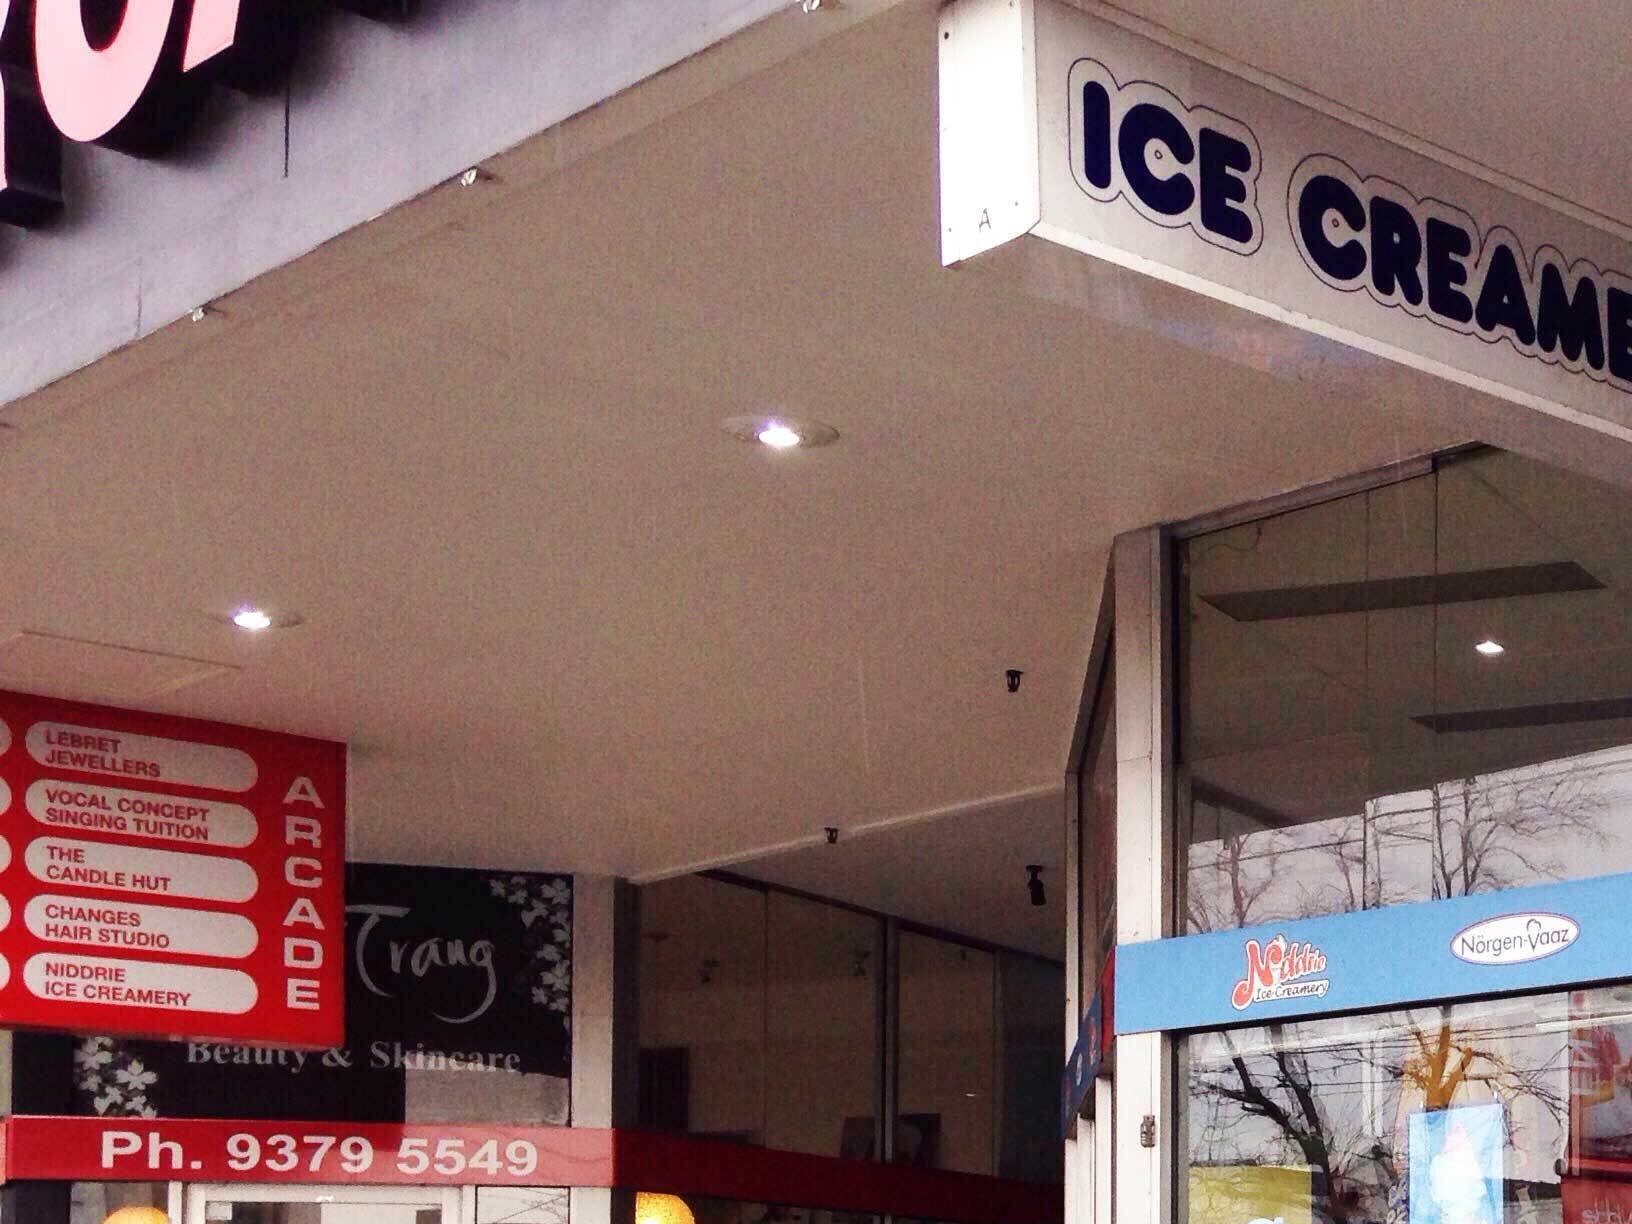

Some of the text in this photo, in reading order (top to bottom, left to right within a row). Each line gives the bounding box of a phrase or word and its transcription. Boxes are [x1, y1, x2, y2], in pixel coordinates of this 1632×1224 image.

[1081, 79, 1255, 245] ICE
[45, 730, 121, 754] LEBRET
[45, 749, 161, 778] JEWELLERS
[45, 788, 210, 822] VOCAL CONCEPT
[45, 807, 209, 841] SINGING TUITION
[46, 845, 85, 864] THE
[46, 865, 171, 892] CANDLE HUT
[281, 776, 326, 1010] ARCADE
[45, 904, 141, 927] CHANGES
[45, 924, 170, 949] HAIR STUDIO
[45, 962, 126, 982] NIDDRIE
[45, 981, 192, 1007] ICE CREAMERY
[1256, 982, 1328, 1000] Ice Creamery
[369, 1040, 522, 1073] Skincare
[101, 1130, 538, 1176] Ph. 9379 5549
